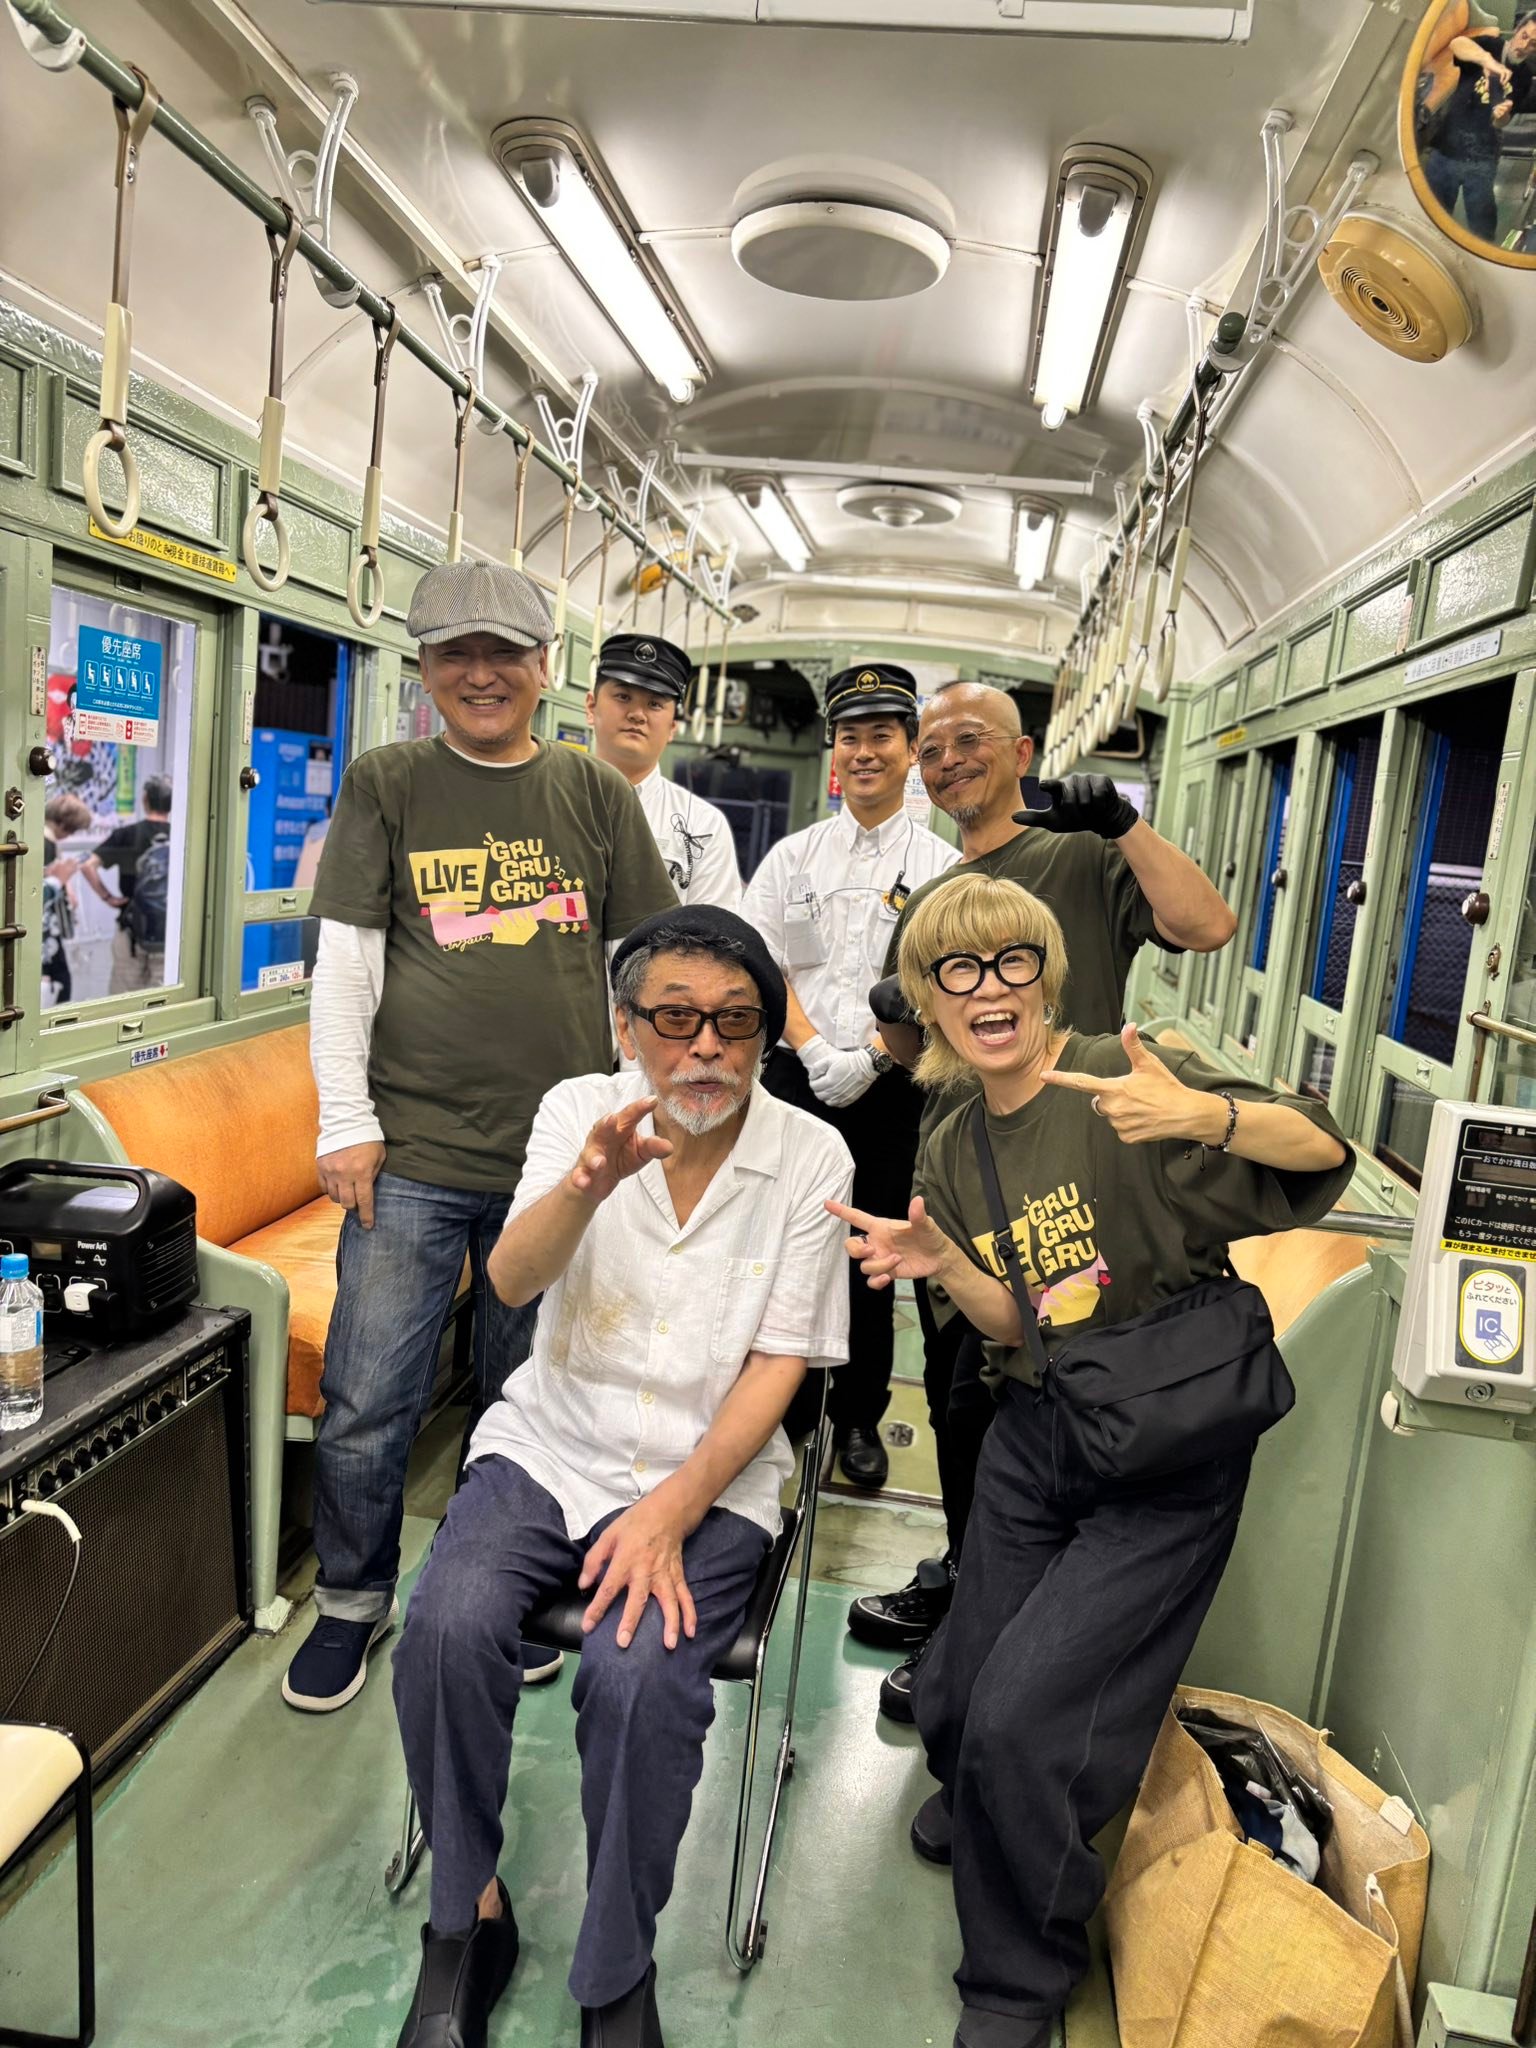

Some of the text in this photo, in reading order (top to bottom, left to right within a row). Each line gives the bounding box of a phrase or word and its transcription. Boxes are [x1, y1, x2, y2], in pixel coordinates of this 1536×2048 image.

[102, 635, 142, 660] 優先座席
[490, 838, 543, 862] GRU
[420, 858, 479, 895] LIVE
[500, 856, 552, 882] GRU
[490, 880, 545, 903] GRU
[134, 1047, 159, 1064] 優先座席
[1028, 1182, 1080, 1226] GRU
[1038, 1203, 1095, 1248] GRU
[1038, 1237, 1097, 1277] GRU
[1466, 1292, 1517, 1306] ふれてください
[1473, 1280, 1511, 1294] ピタッと
[1479, 1316, 1498, 1333] IC
